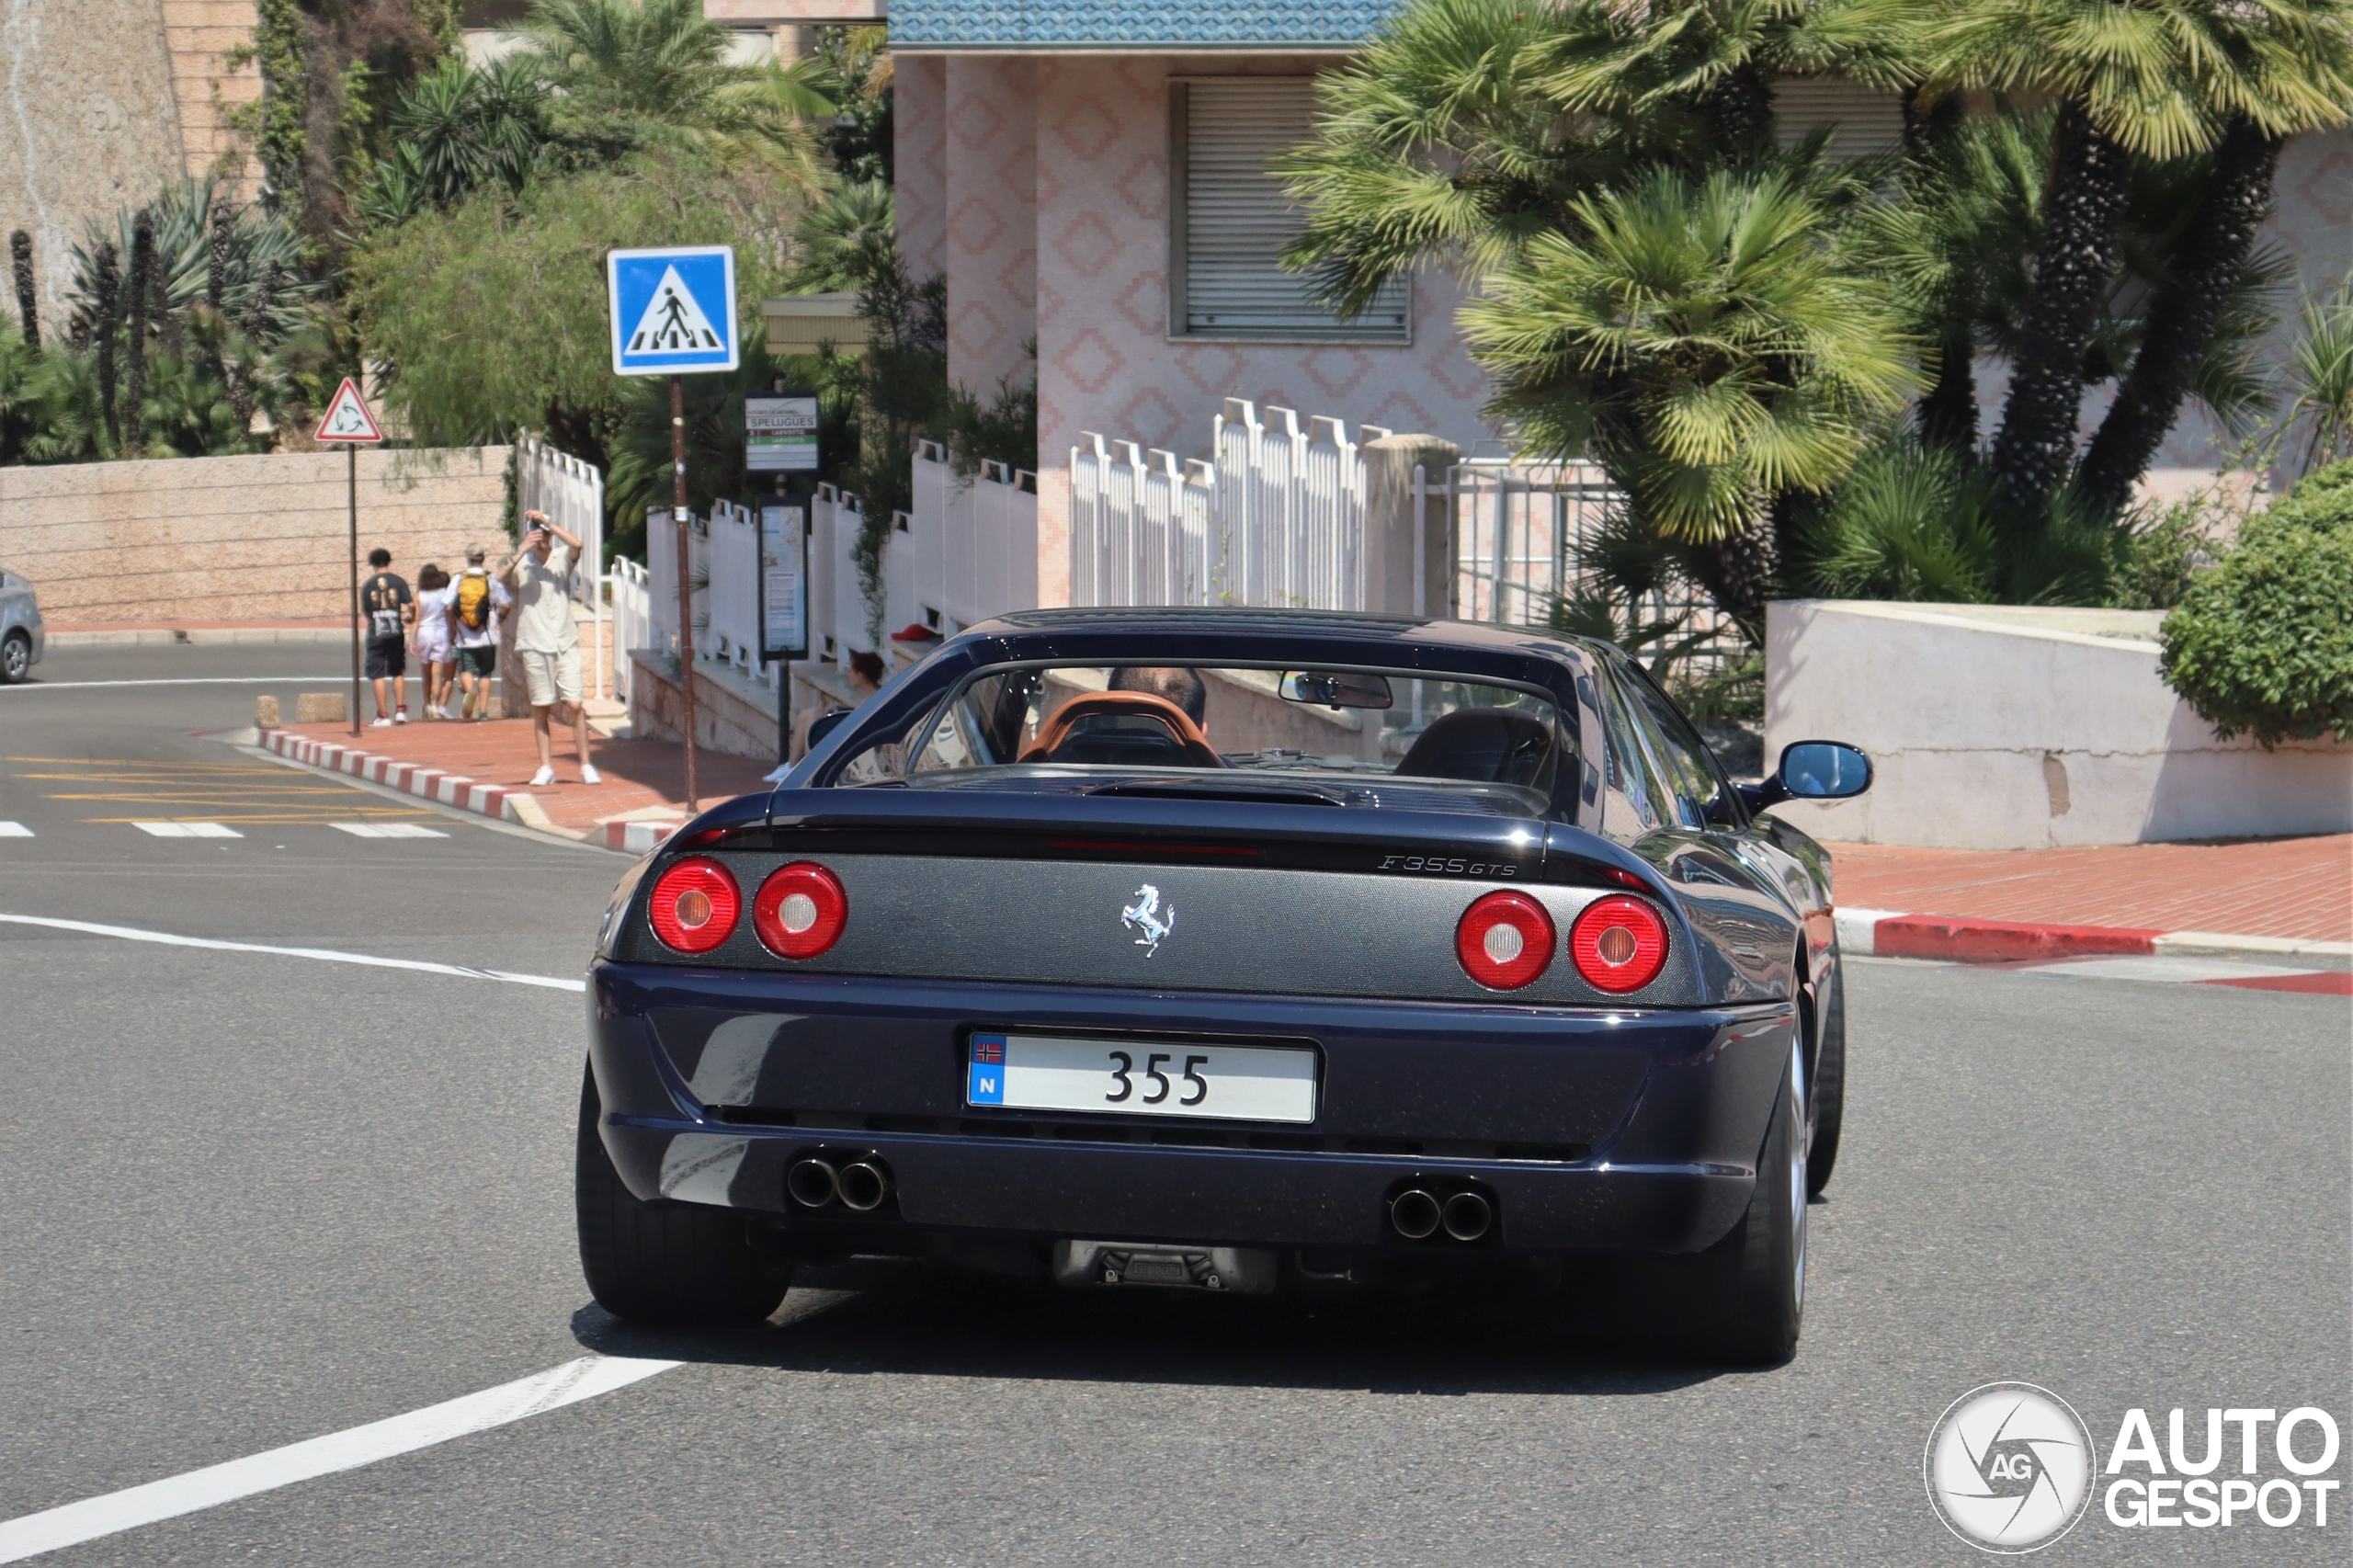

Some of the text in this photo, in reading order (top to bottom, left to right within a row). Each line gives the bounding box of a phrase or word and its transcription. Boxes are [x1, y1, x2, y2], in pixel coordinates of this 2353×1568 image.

[750, 417, 814, 427] SPELUGUES
[1378, 856, 1518, 876] F355 GTS
[979, 1078, 995, 1094] N
[1106, 1051, 1209, 1107] 355
